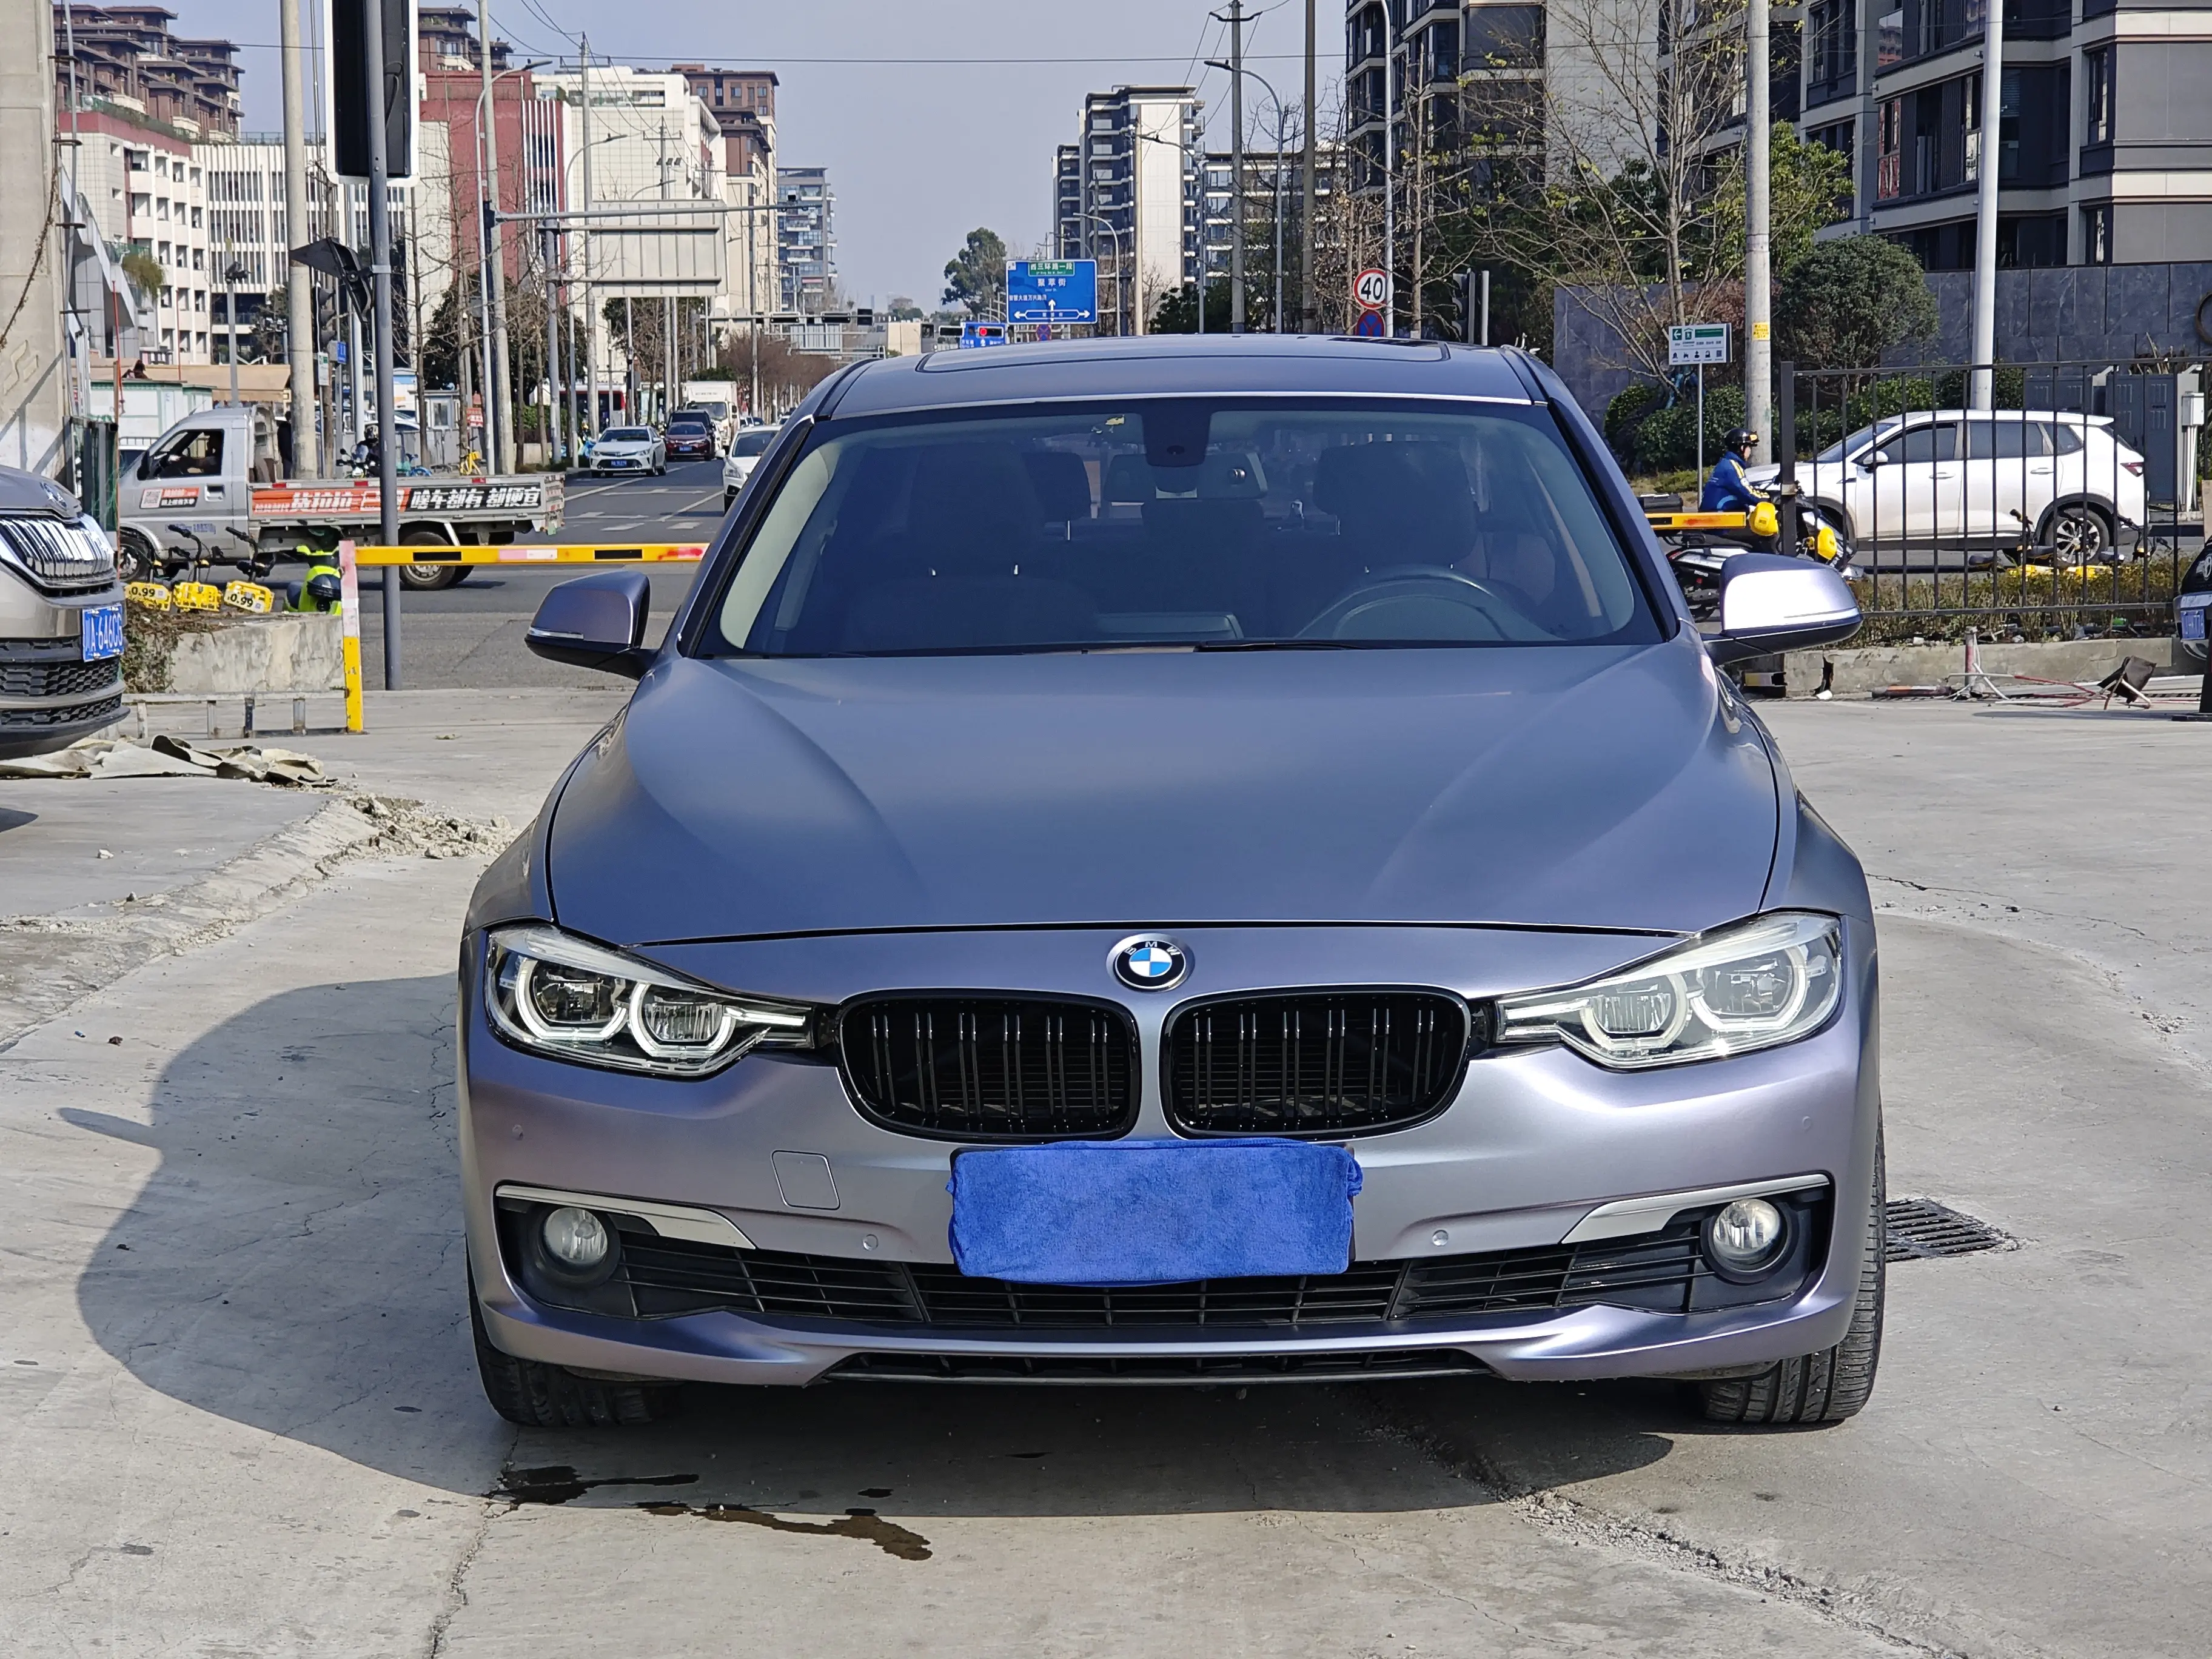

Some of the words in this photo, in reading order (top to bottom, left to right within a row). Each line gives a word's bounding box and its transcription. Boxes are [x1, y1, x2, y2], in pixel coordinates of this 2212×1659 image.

[1361, 276, 1383, 300] 40
[289, 491, 353, 513] 货拉拉
[410, 488, 484, 509] 啥车都有
[486, 486, 541, 508] 都便宜
[1124, 940, 1181, 956] BMW
